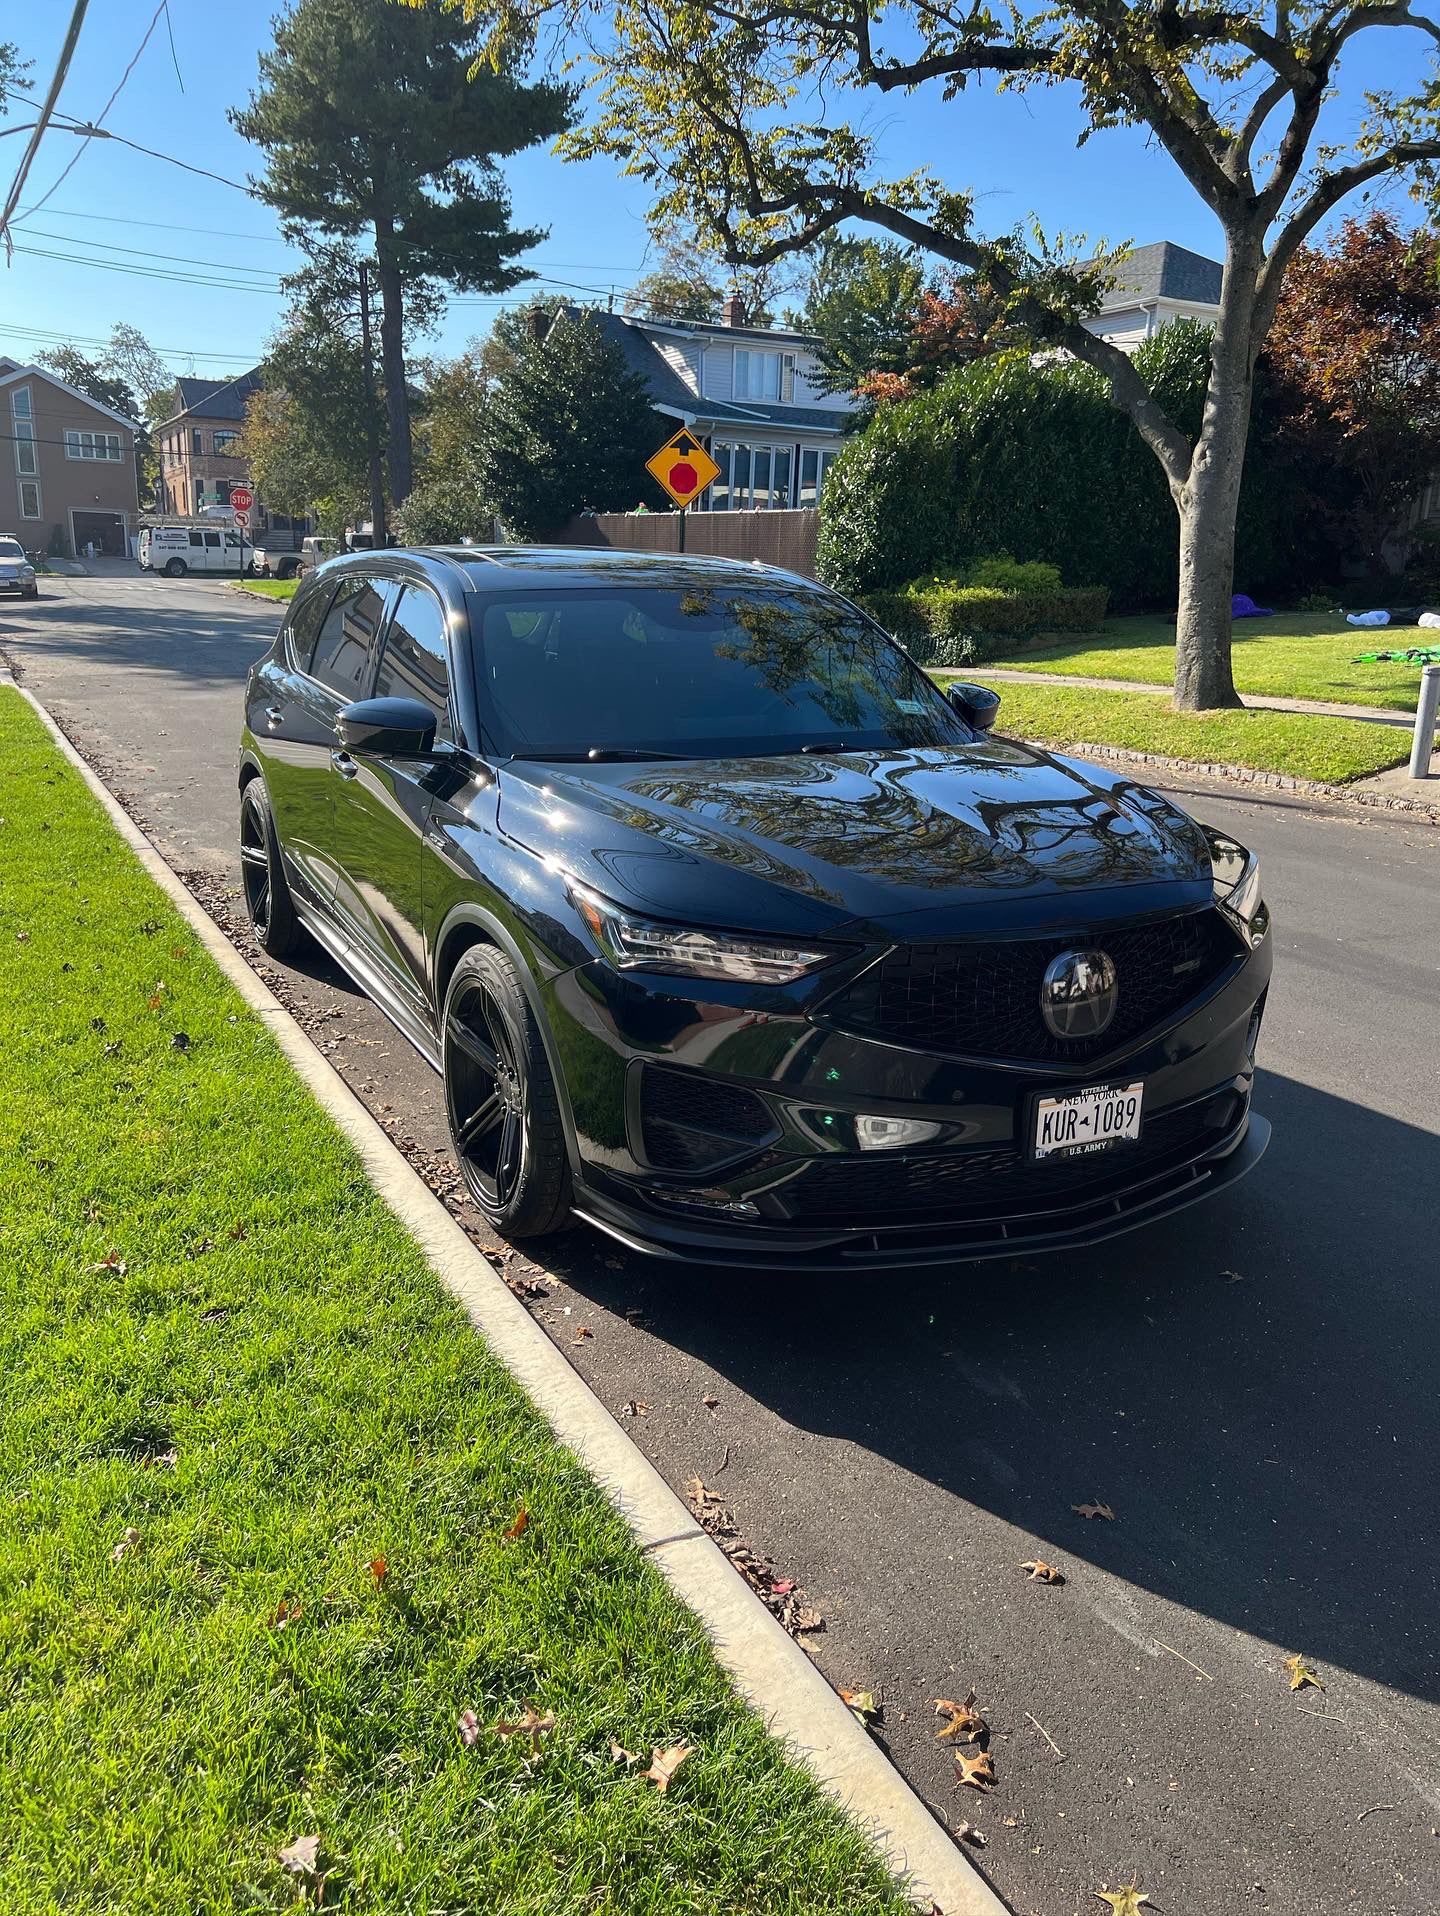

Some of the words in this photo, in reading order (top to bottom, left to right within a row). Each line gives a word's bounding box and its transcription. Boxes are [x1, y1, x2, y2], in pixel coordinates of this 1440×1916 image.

[232, 495, 251, 505] STOP
[1081, 1085, 1109, 1095] VETERAN
[1064, 1095, 1088, 1107] NEW
[1092, 1089, 1120, 1102] YORK
[1041, 1109, 1078, 1145] KUR
[1093, 1097, 1137, 1136] 1089
[1069, 1144, 1083, 1156] U.S.
[1084, 1141, 1108, 1153] ARMY
